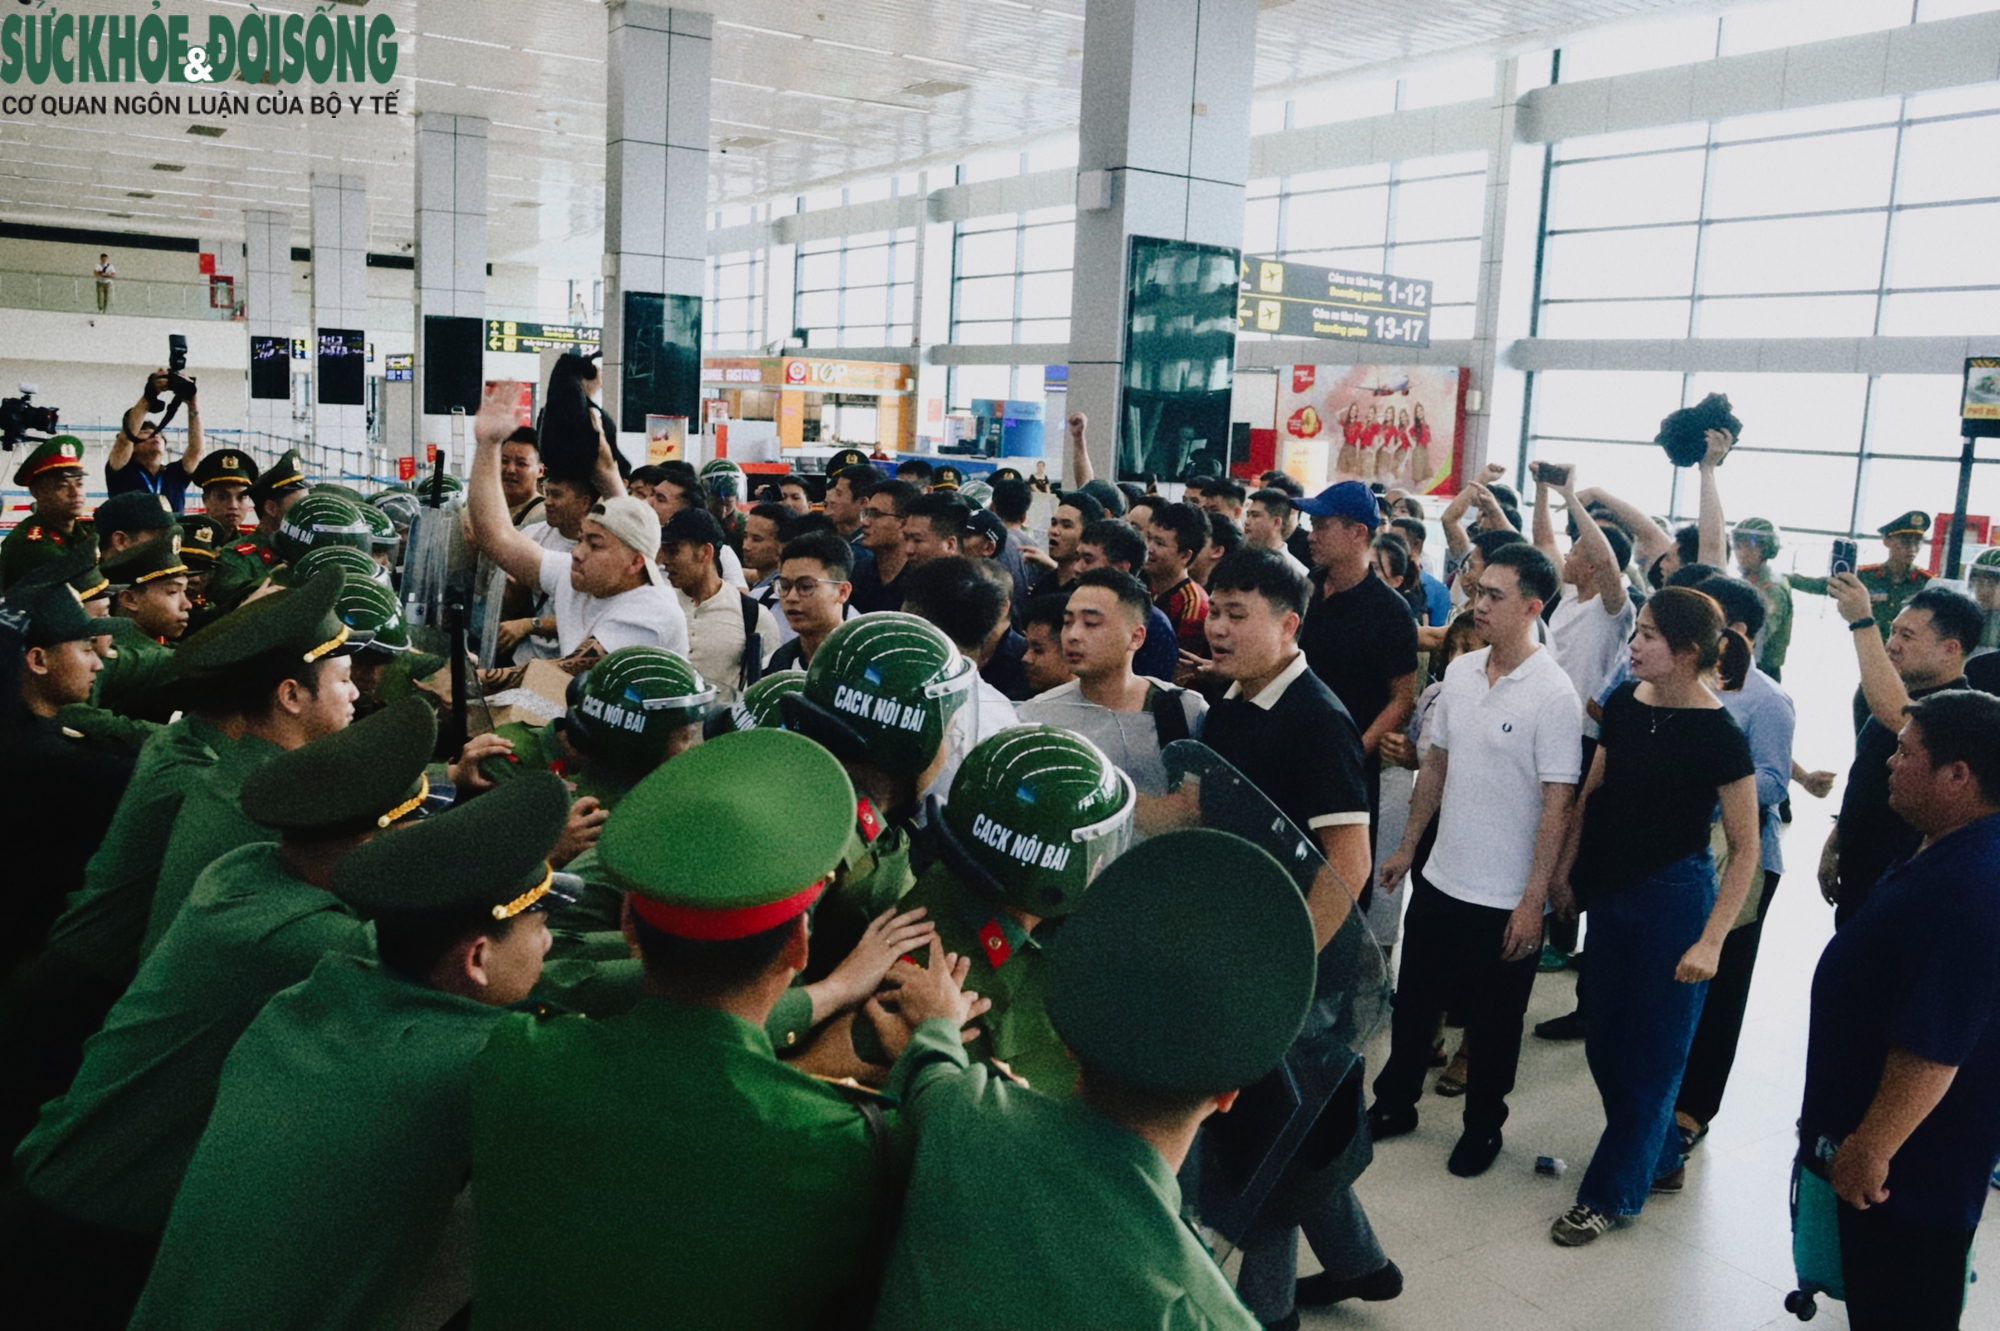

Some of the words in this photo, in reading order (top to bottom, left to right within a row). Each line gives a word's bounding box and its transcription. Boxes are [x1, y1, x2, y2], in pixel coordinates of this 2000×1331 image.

[1388, 281, 1426, 307] 1-12
[1375, 316, 1424, 342] 13-17
[808, 361, 848, 384] TOP
[603, 703, 625, 729] NỘI
[834, 684, 873, 718] CACK
[871, 696, 901, 729] NỘI
[972, 813, 1013, 853] CACK
[1009, 833, 1043, 867] NỘI
